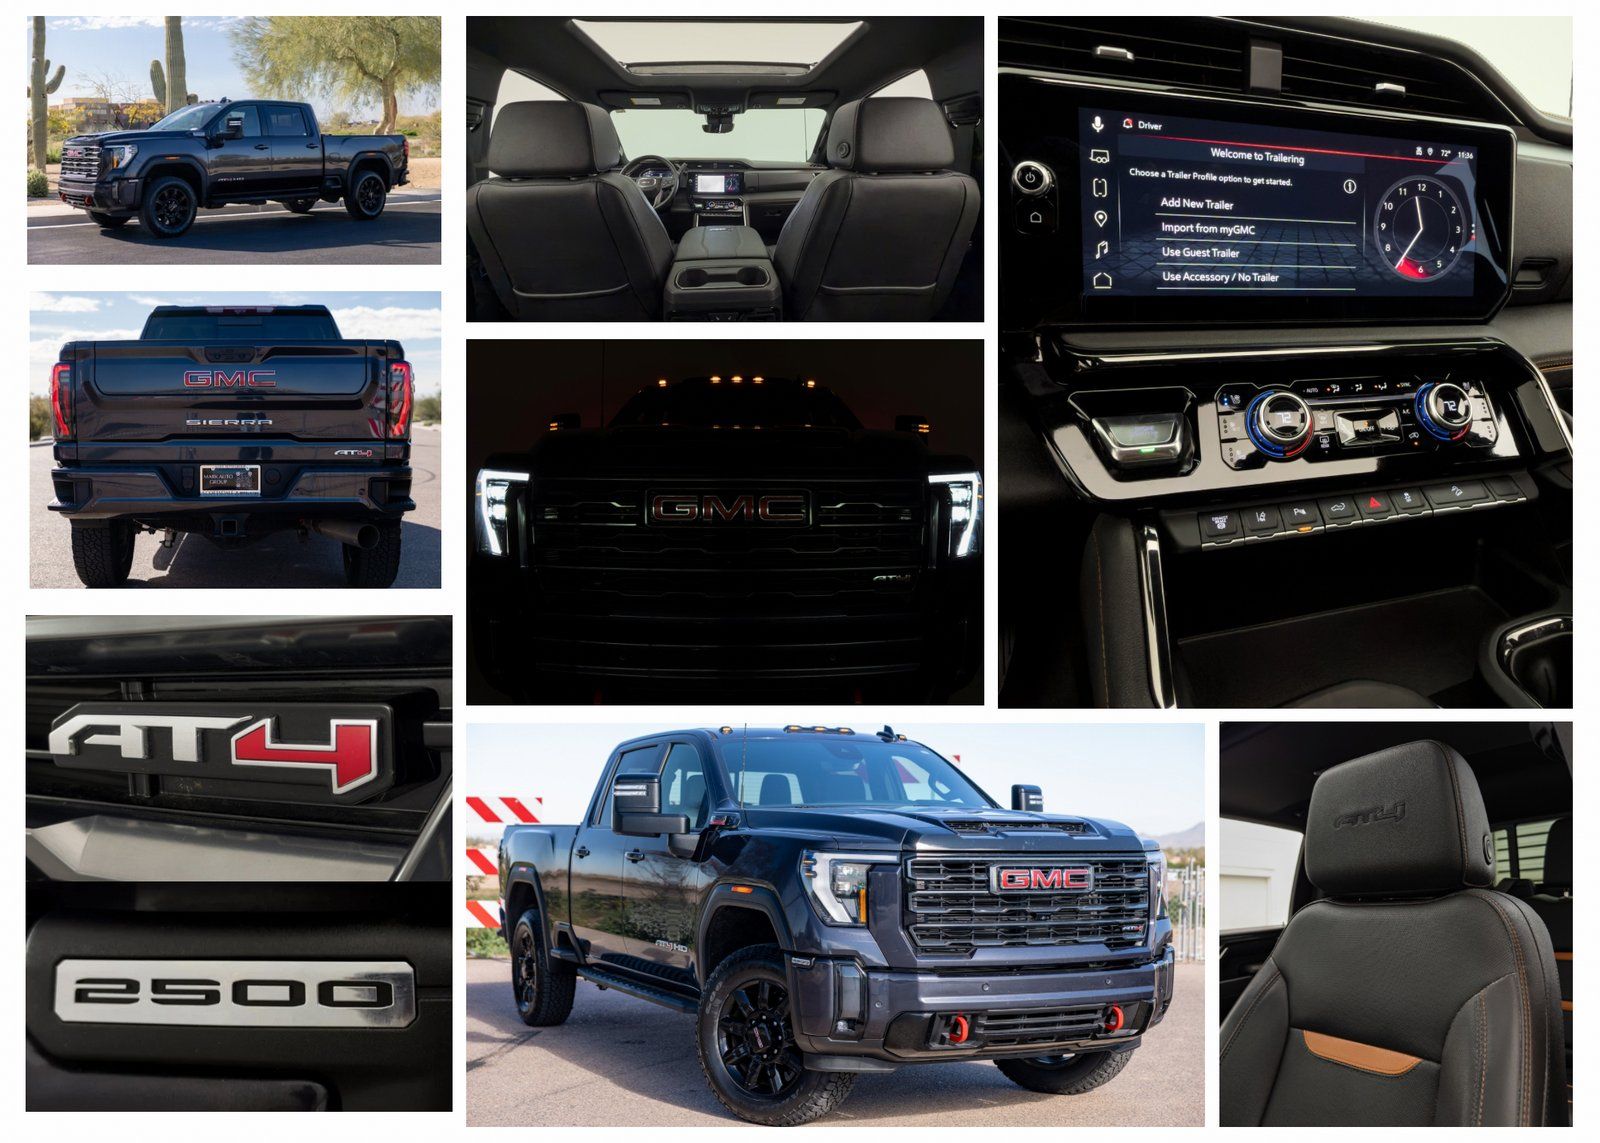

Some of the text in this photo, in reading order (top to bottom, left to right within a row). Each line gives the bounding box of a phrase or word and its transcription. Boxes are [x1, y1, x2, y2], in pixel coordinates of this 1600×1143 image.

[1138, 120, 1162, 131] Driver
[1210, 147, 1305, 166] Welcome to Trailering
[1458, 151, 1473, 160] 11:36
[1129, 168, 1159, 178] Choose
[1167, 170, 1191, 180] Trailer
[1192, 172, 1217, 182] Profile
[1218, 174, 1242, 184] option
[1244, 176, 1251, 184] to
[1252, 177, 1265, 187] get
[1266, 177, 1293, 187] started.
[1398, 187, 1407, 196] 11
[1417, 183, 1426, 192] 12
[1438, 190, 1442, 198] 1
[1161, 197, 1234, 211] Add New Trailer
[1384, 202, 1393, 211] 10
[1451, 206, 1456, 214] 2
[1161, 222, 1256, 237] Import from myGMC
[1380, 222, 1386, 230] 9
[1455, 225, 1461, 234] 3
[1162, 247, 1240, 259] Use Guest Trailer
[1385, 243, 1391, 252] 8
[1449, 245, 1455, 254] 4
[1418, 265, 1424, 273] 6
[1436, 260, 1442, 268] 5
[1162, 271, 1181, 281] Use
[1182, 271, 1230, 284] Accessory
[1238, 272, 1251, 282] No
[1252, 272, 1279, 282] Trailer
[183, 370, 276, 388] GMC
[1443, 400, 1457, 412] 72
[1276, 412, 1292, 424] 72
[652, 494, 806, 521] GMC
[48, 713, 378, 795] AT4
[1001, 868, 1089, 889] GMC
[673, 943, 688, 953] HD
[73, 977, 395, 1008] 2500
